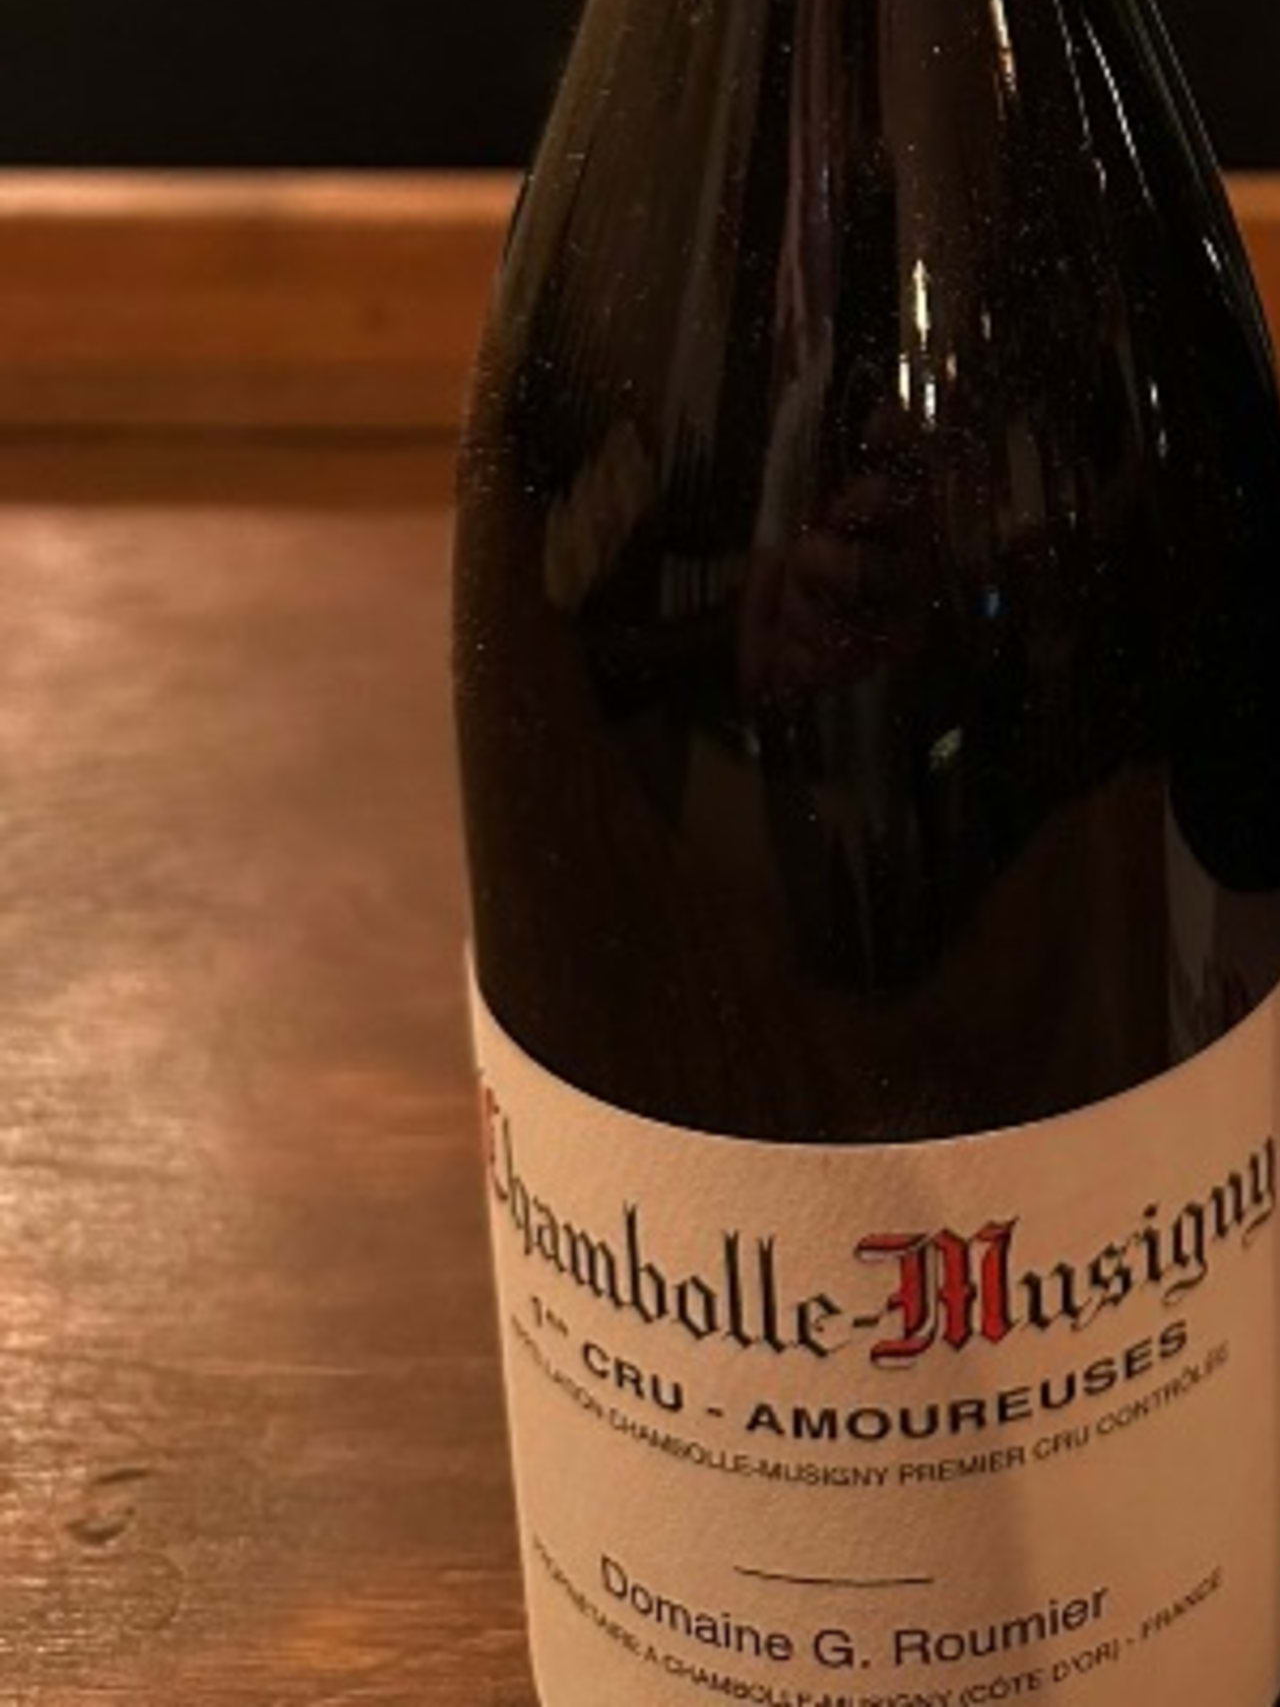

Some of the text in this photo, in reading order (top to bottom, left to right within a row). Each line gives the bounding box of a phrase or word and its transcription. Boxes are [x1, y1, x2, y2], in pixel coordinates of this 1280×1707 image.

[582, 1340, 684, 1412] CRU
[745, 1319, 1190, 1441] AMOUREUSES
[608, 1406, 890, 1488] CHAMBOLLE-MUSIGNY
[899, 1445, 1027, 1487] PREMIER
[1031, 1425, 1091, 1462] CRU
[600, 1550, 1110, 1670] Domaine G. Roumier
[1139, 1565, 1223, 1641] FRANCE
